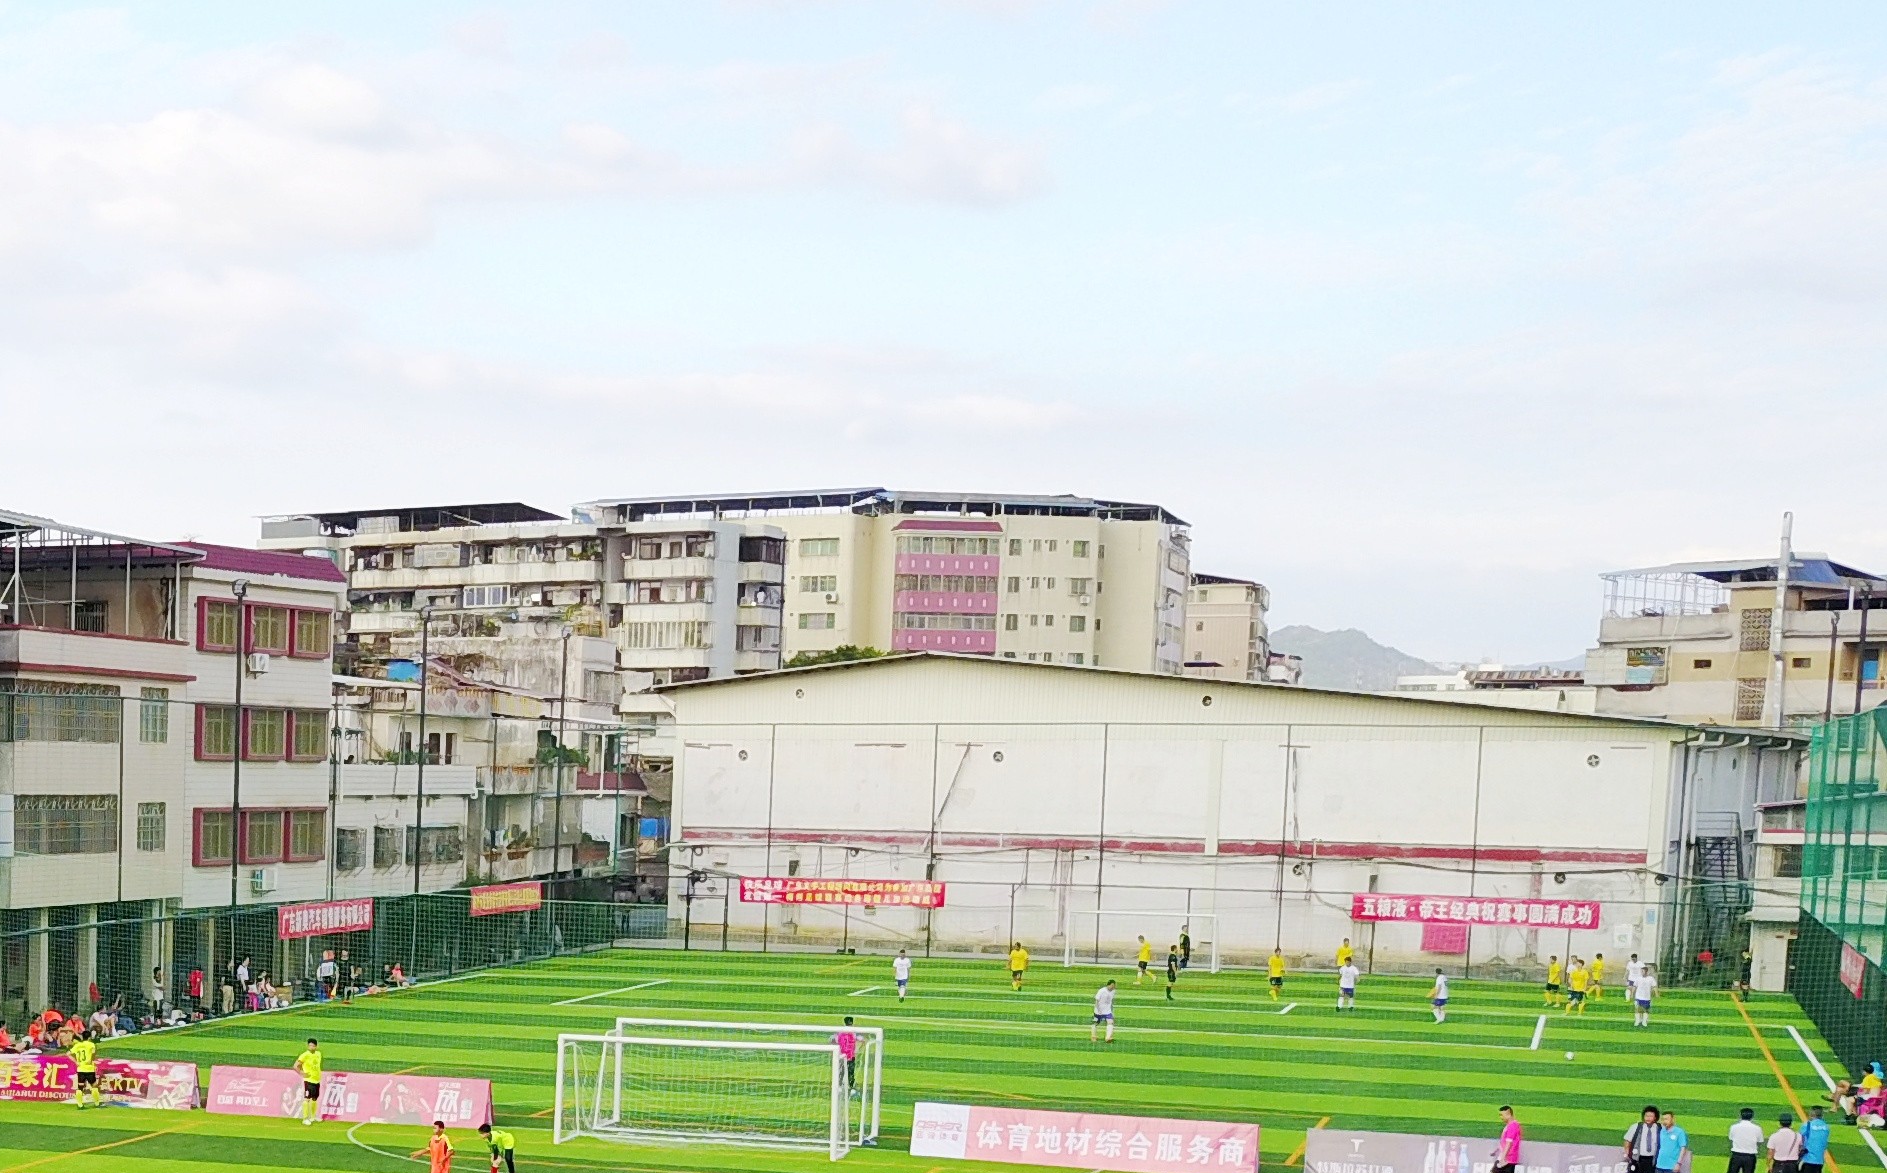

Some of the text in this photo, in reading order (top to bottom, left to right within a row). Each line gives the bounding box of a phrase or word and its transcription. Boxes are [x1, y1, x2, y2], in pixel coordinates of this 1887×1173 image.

[976, 1120, 1247, 1167] 体育地材综合服务商
